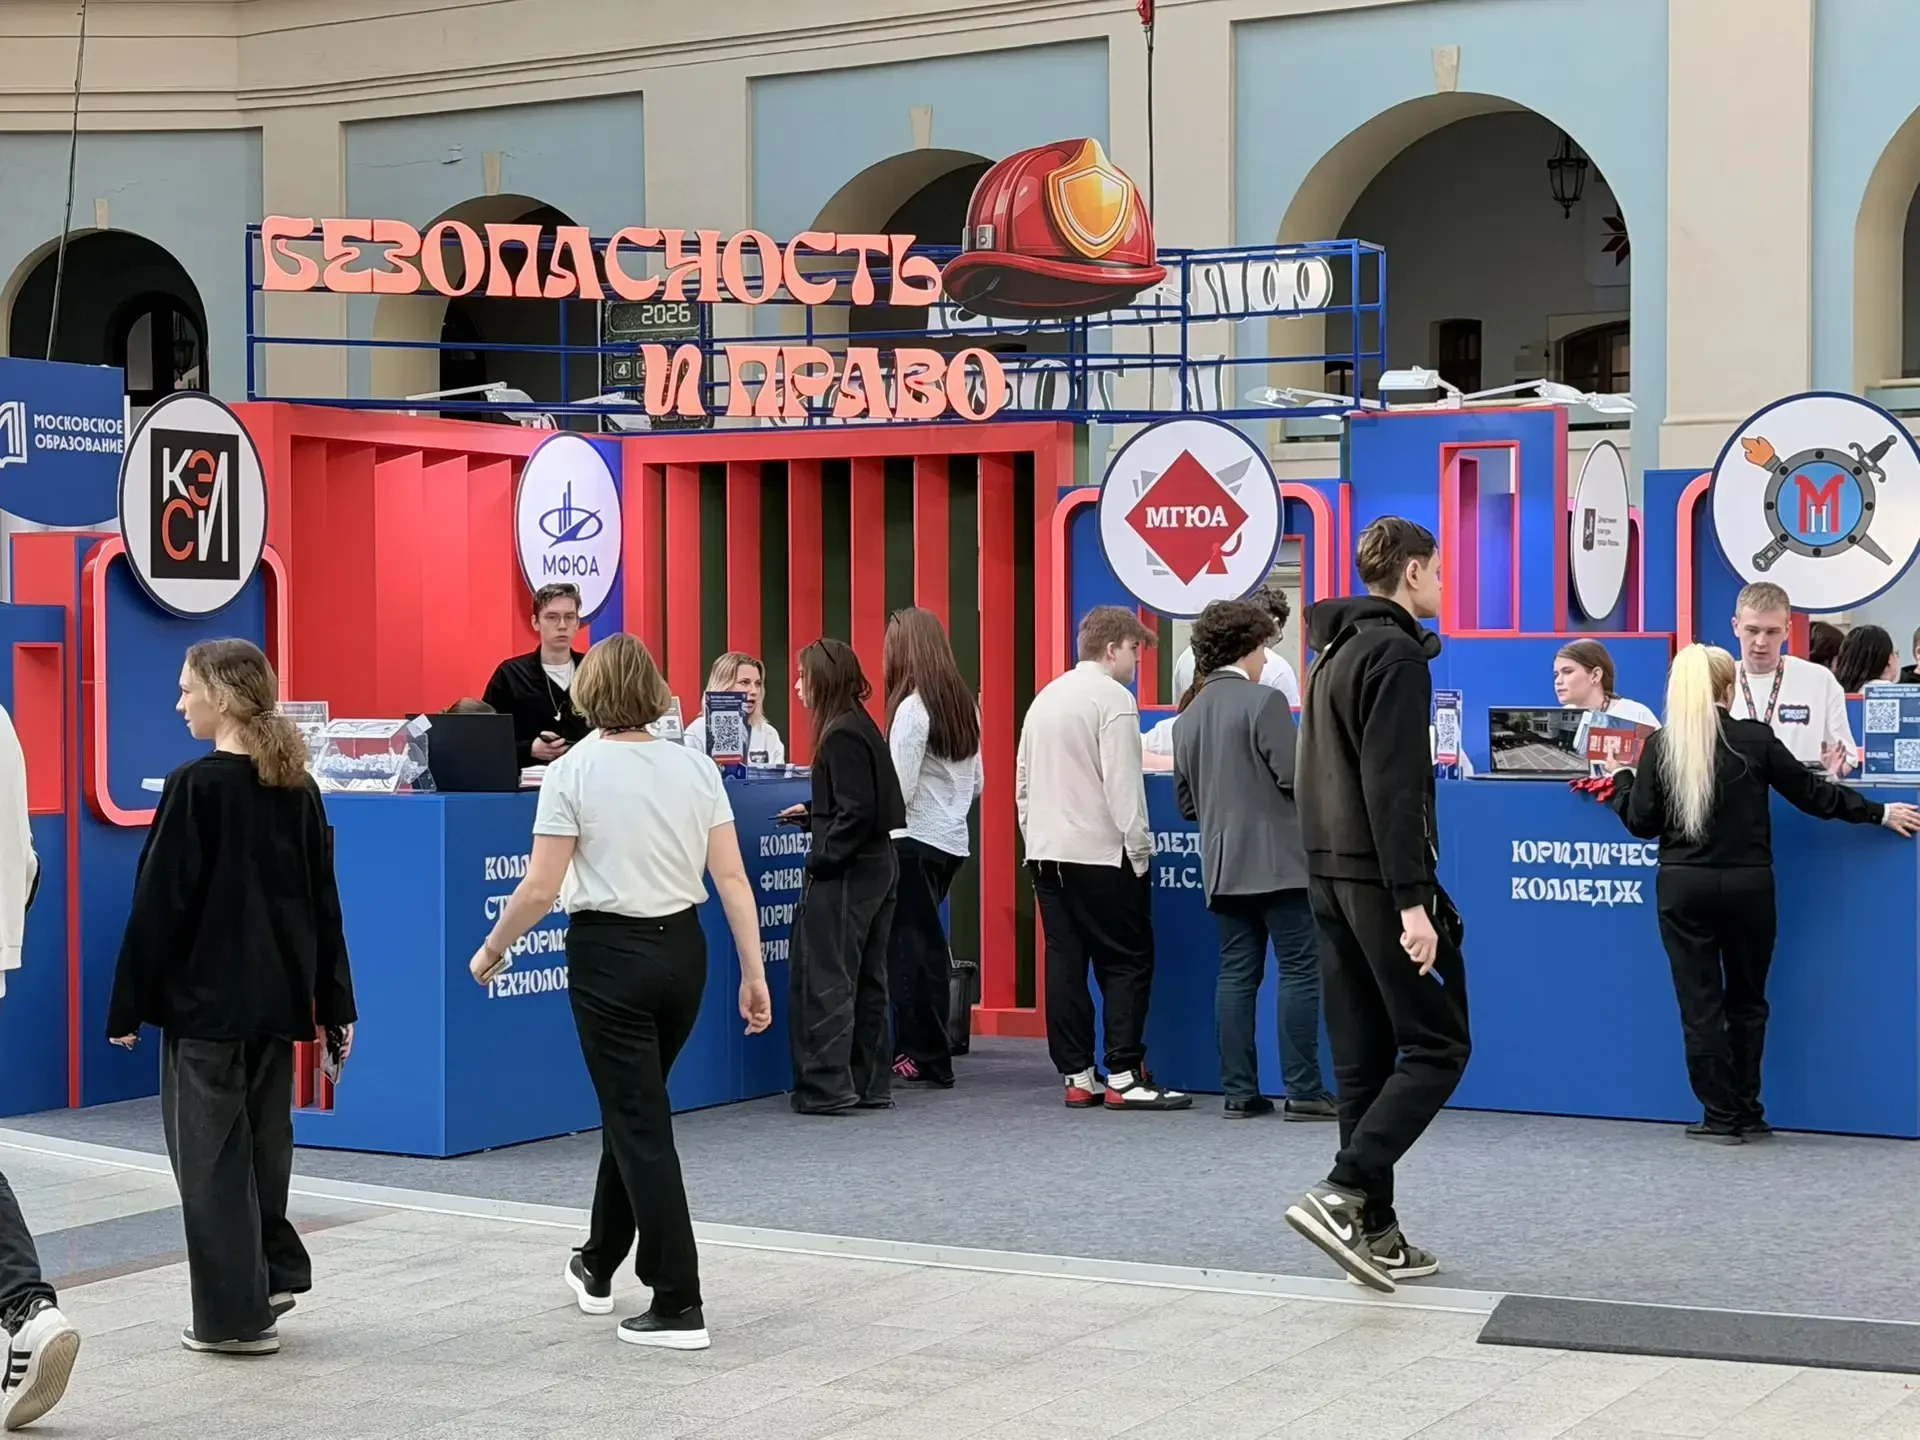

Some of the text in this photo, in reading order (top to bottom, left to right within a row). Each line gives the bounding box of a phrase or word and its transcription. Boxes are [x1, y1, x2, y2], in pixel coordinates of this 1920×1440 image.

[261, 215, 943, 307] БЕЗОПАСНОСТЬ
[641, 303, 691, 325] 2026
[640, 343, 706, 416] И
[725, 345, 1006, 422] ПРАВО
[33, 413, 124, 435] МОСКОВСКОЕ
[34, 433, 124, 454] ОБРАЗОВАНИЕ
[1145, 505, 1229, 528] МГЮА
[543, 554, 600, 576] МФЮА
[760, 832, 813, 857] КОЛЛЕД
[1511, 840, 1660, 870] ЮРИДИЧЕС
[484, 854, 531, 881] КОЛЛ
[1511, 877, 1643, 908] КОЛЛЕДЖ
